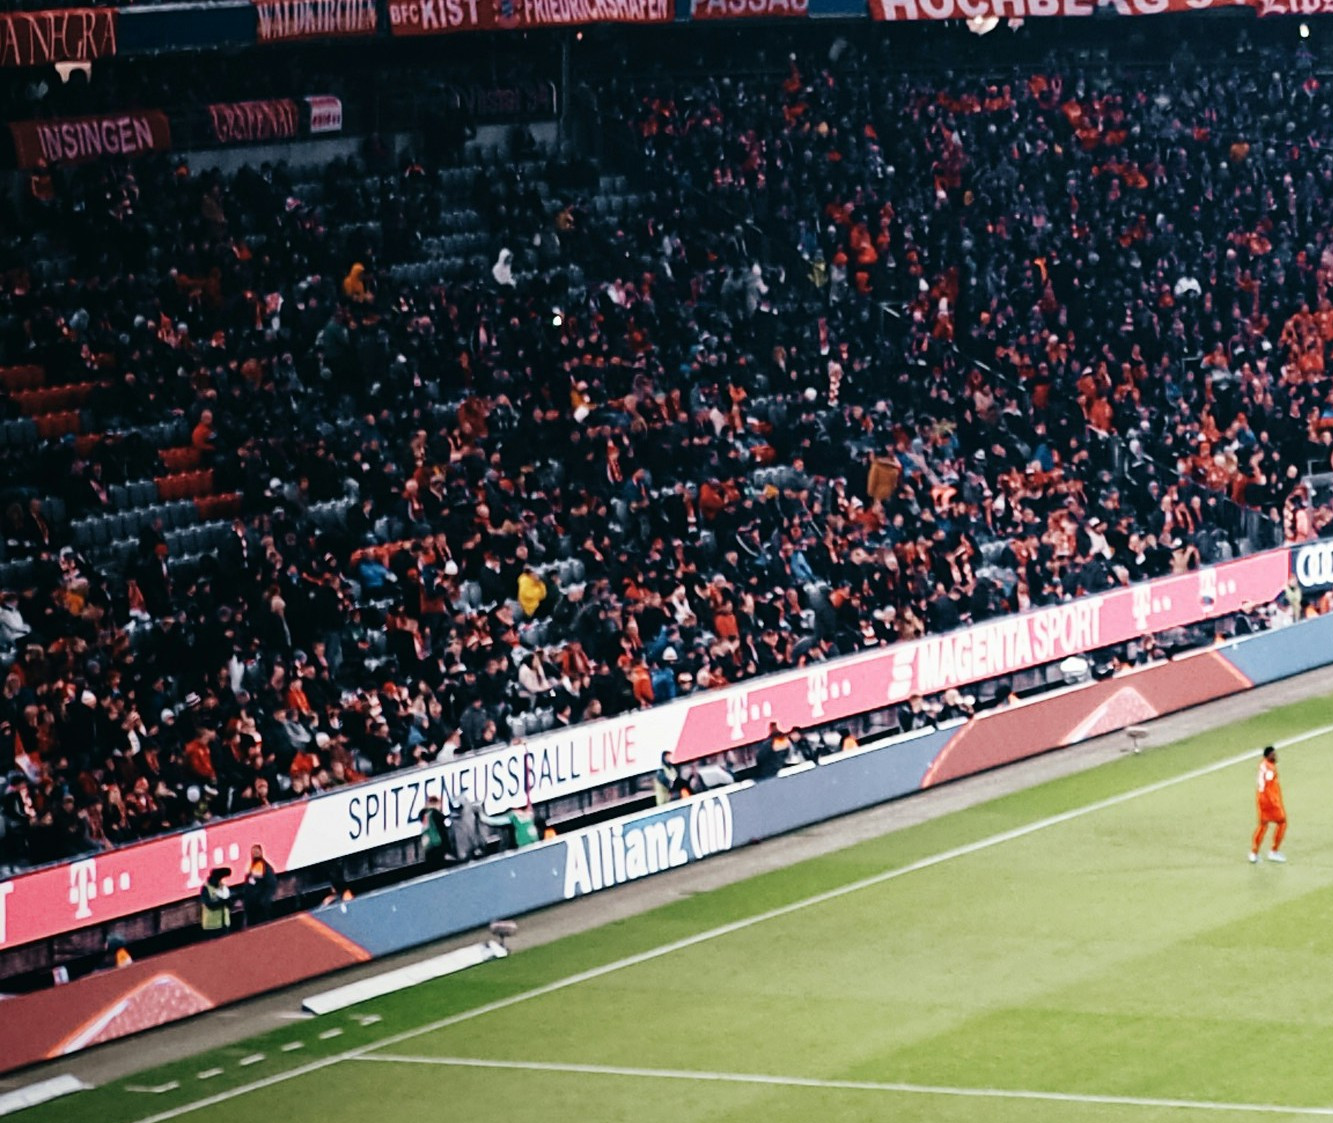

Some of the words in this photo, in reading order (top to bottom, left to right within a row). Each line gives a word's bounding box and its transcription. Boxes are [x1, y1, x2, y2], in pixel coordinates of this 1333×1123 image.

[389, 4, 419, 25] BFC
[420, 0, 478, 30] KIST
[37, 117, 154, 160] INSINGEN
[916, 617, 1033, 692] MAGENTA
[1033, 598, 1105, 660] SPORT
[588, 724, 637, 776] LIVE
[563, 814, 689, 899] Allianz
